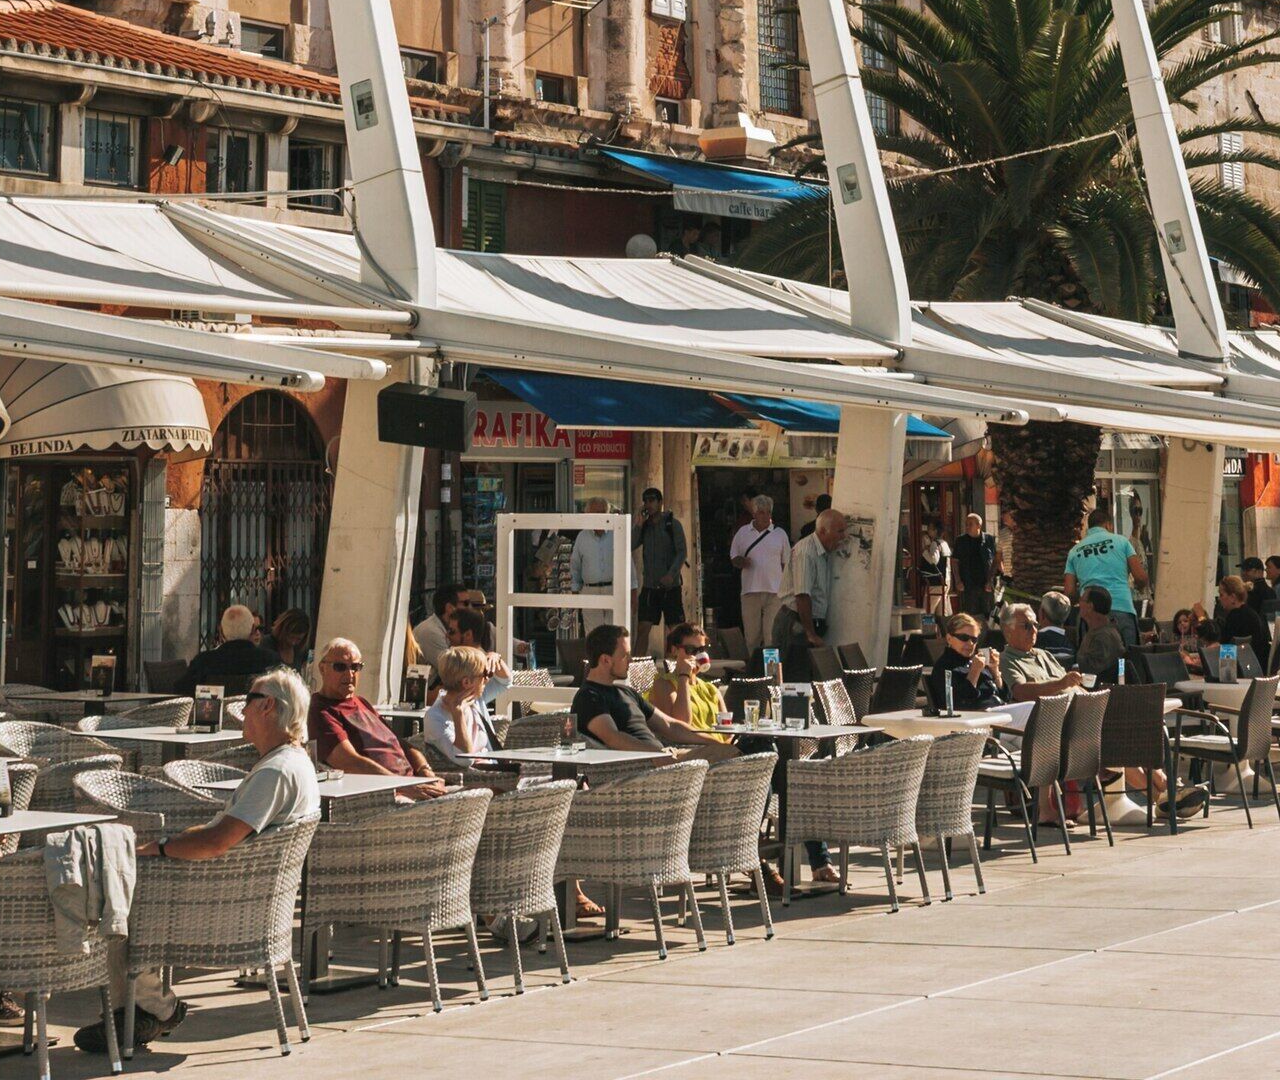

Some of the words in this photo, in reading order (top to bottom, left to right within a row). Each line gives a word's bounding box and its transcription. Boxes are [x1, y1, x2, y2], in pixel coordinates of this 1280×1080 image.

[728, 202, 753, 216] caffe
[753, 204, 771, 219] bar
[122, 429, 180, 442] ZLATARNA
[577, 430, 613, 438] SOUENIRS
[10, 440, 74, 456] BELINDA
[578, 443, 592, 453] ECO
[592, 443, 626, 454] PRODUCTS
